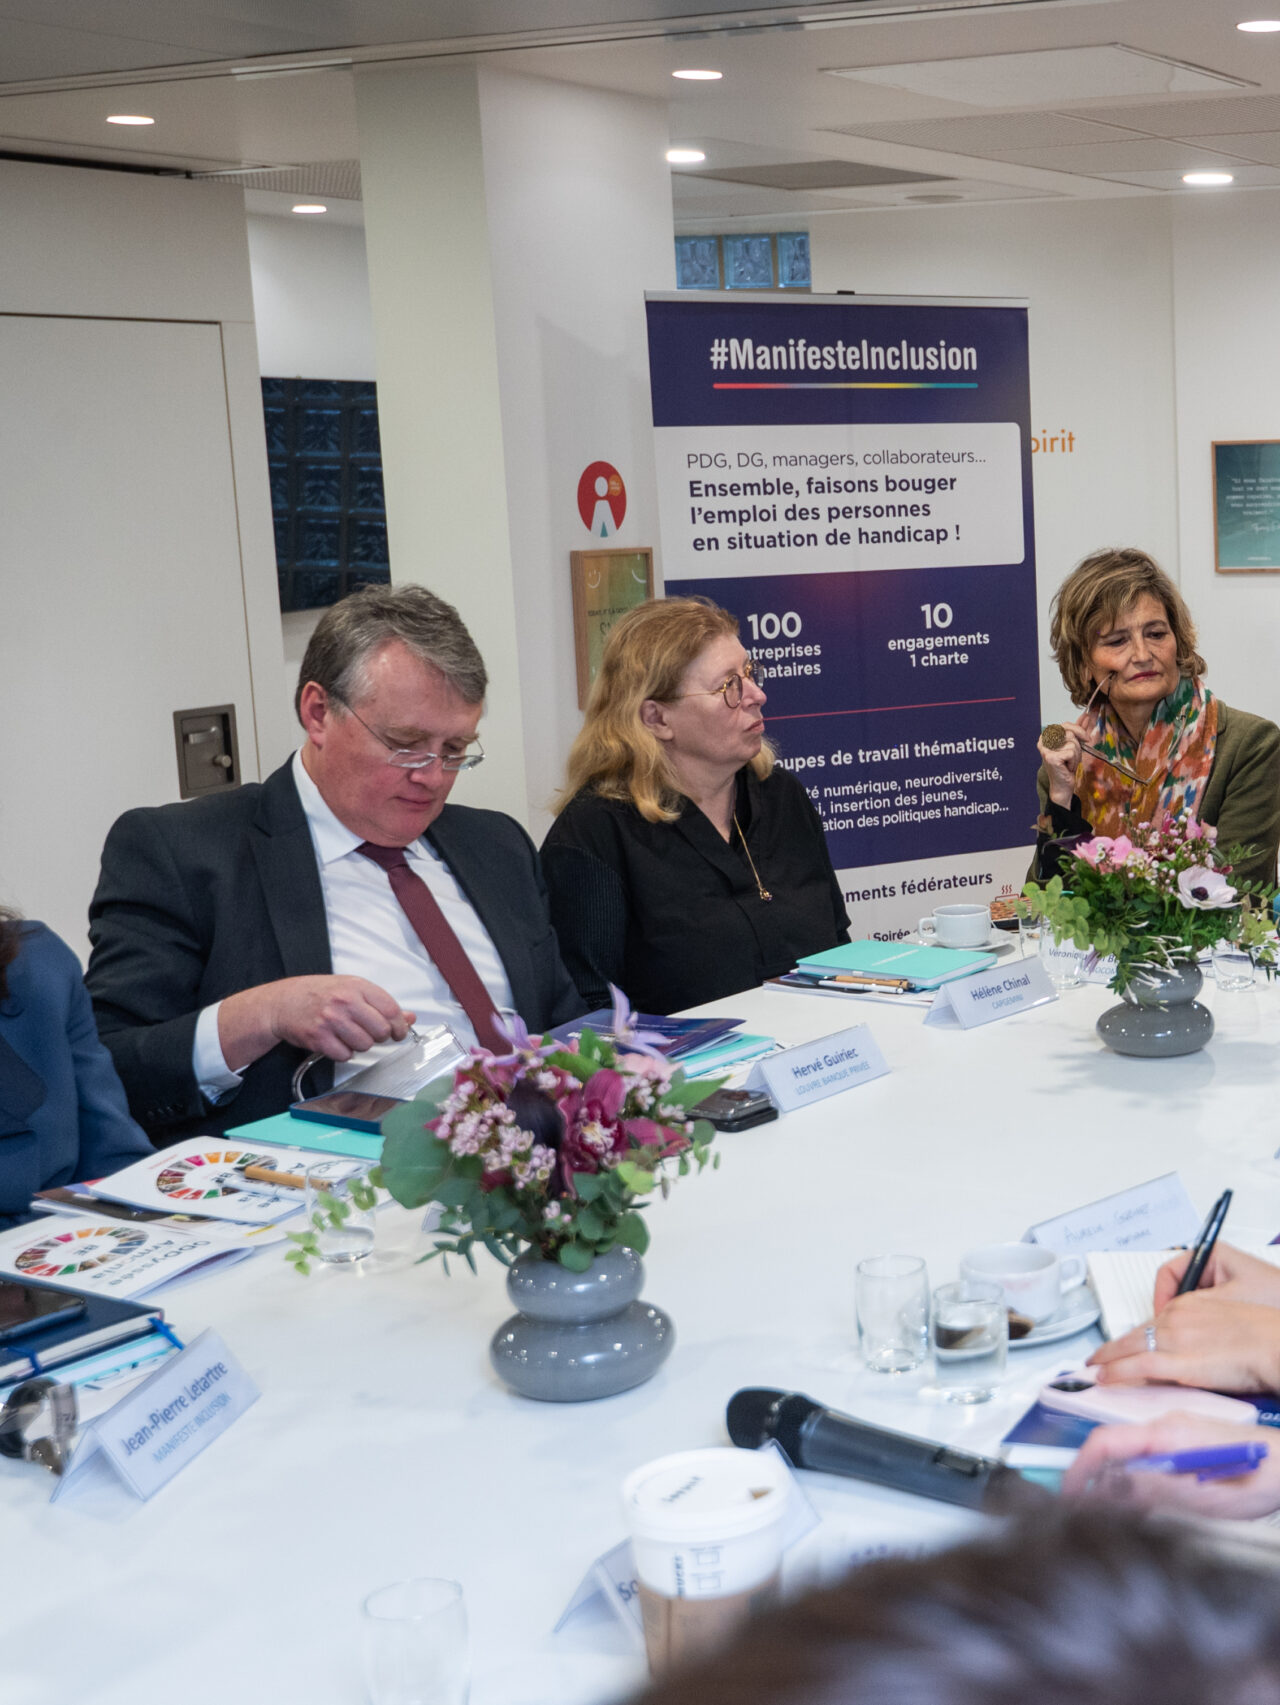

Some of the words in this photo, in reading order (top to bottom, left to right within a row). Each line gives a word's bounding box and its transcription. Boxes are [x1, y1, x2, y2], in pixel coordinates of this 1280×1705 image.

[709, 338, 978, 371] #ManifesteInclusion
[687, 453, 732, 470] PDG,
[737, 452, 768, 469] DG,
[772, 452, 859, 470] managers,
[863, 449, 987, 467] collaborateurs...
[688, 479, 800, 499] Ensemble,
[806, 475, 879, 495] faisons
[885, 474, 957, 497] bouger
[690, 504, 778, 527] l'emploi
[784, 502, 820, 522] des
[827, 501, 931, 525] personnes
[692, 534, 720, 552] en
[726, 528, 819, 550] situation
[825, 526, 852, 546] de
[858, 525, 949, 547] handicap
[954, 524, 961, 541] !
[746, 610, 802, 640] 100
[921, 602, 954, 629] 10
[887, 631, 990, 652] engagements
[909, 654, 917, 667] 1
[921, 651, 969, 667] charte
[830, 749, 853, 766] de
[857, 742, 910, 763] travail
[913, 735, 1015, 759] thématiques
[823, 780, 901, 798] numérique,
[904, 767, 1003, 790] neurodiversité,
[829, 796, 891, 814] insertion
[894, 790, 918, 807] des
[920, 788, 968, 807] jeunes,
[856, 813, 880, 828] des
[882, 805, 942, 828] politiques
[943, 800, 1009, 819] handicap...
[900, 871, 993, 896] fédérateurs
[970, 984, 1003, 1001] Hélène
[1002, 973, 1031, 991] Chinal
[791, 1057, 824, 1080] Hervé
[120, 1393, 190, 1457] Jean-Pierre
[183, 1360, 230, 1402] Letartre
